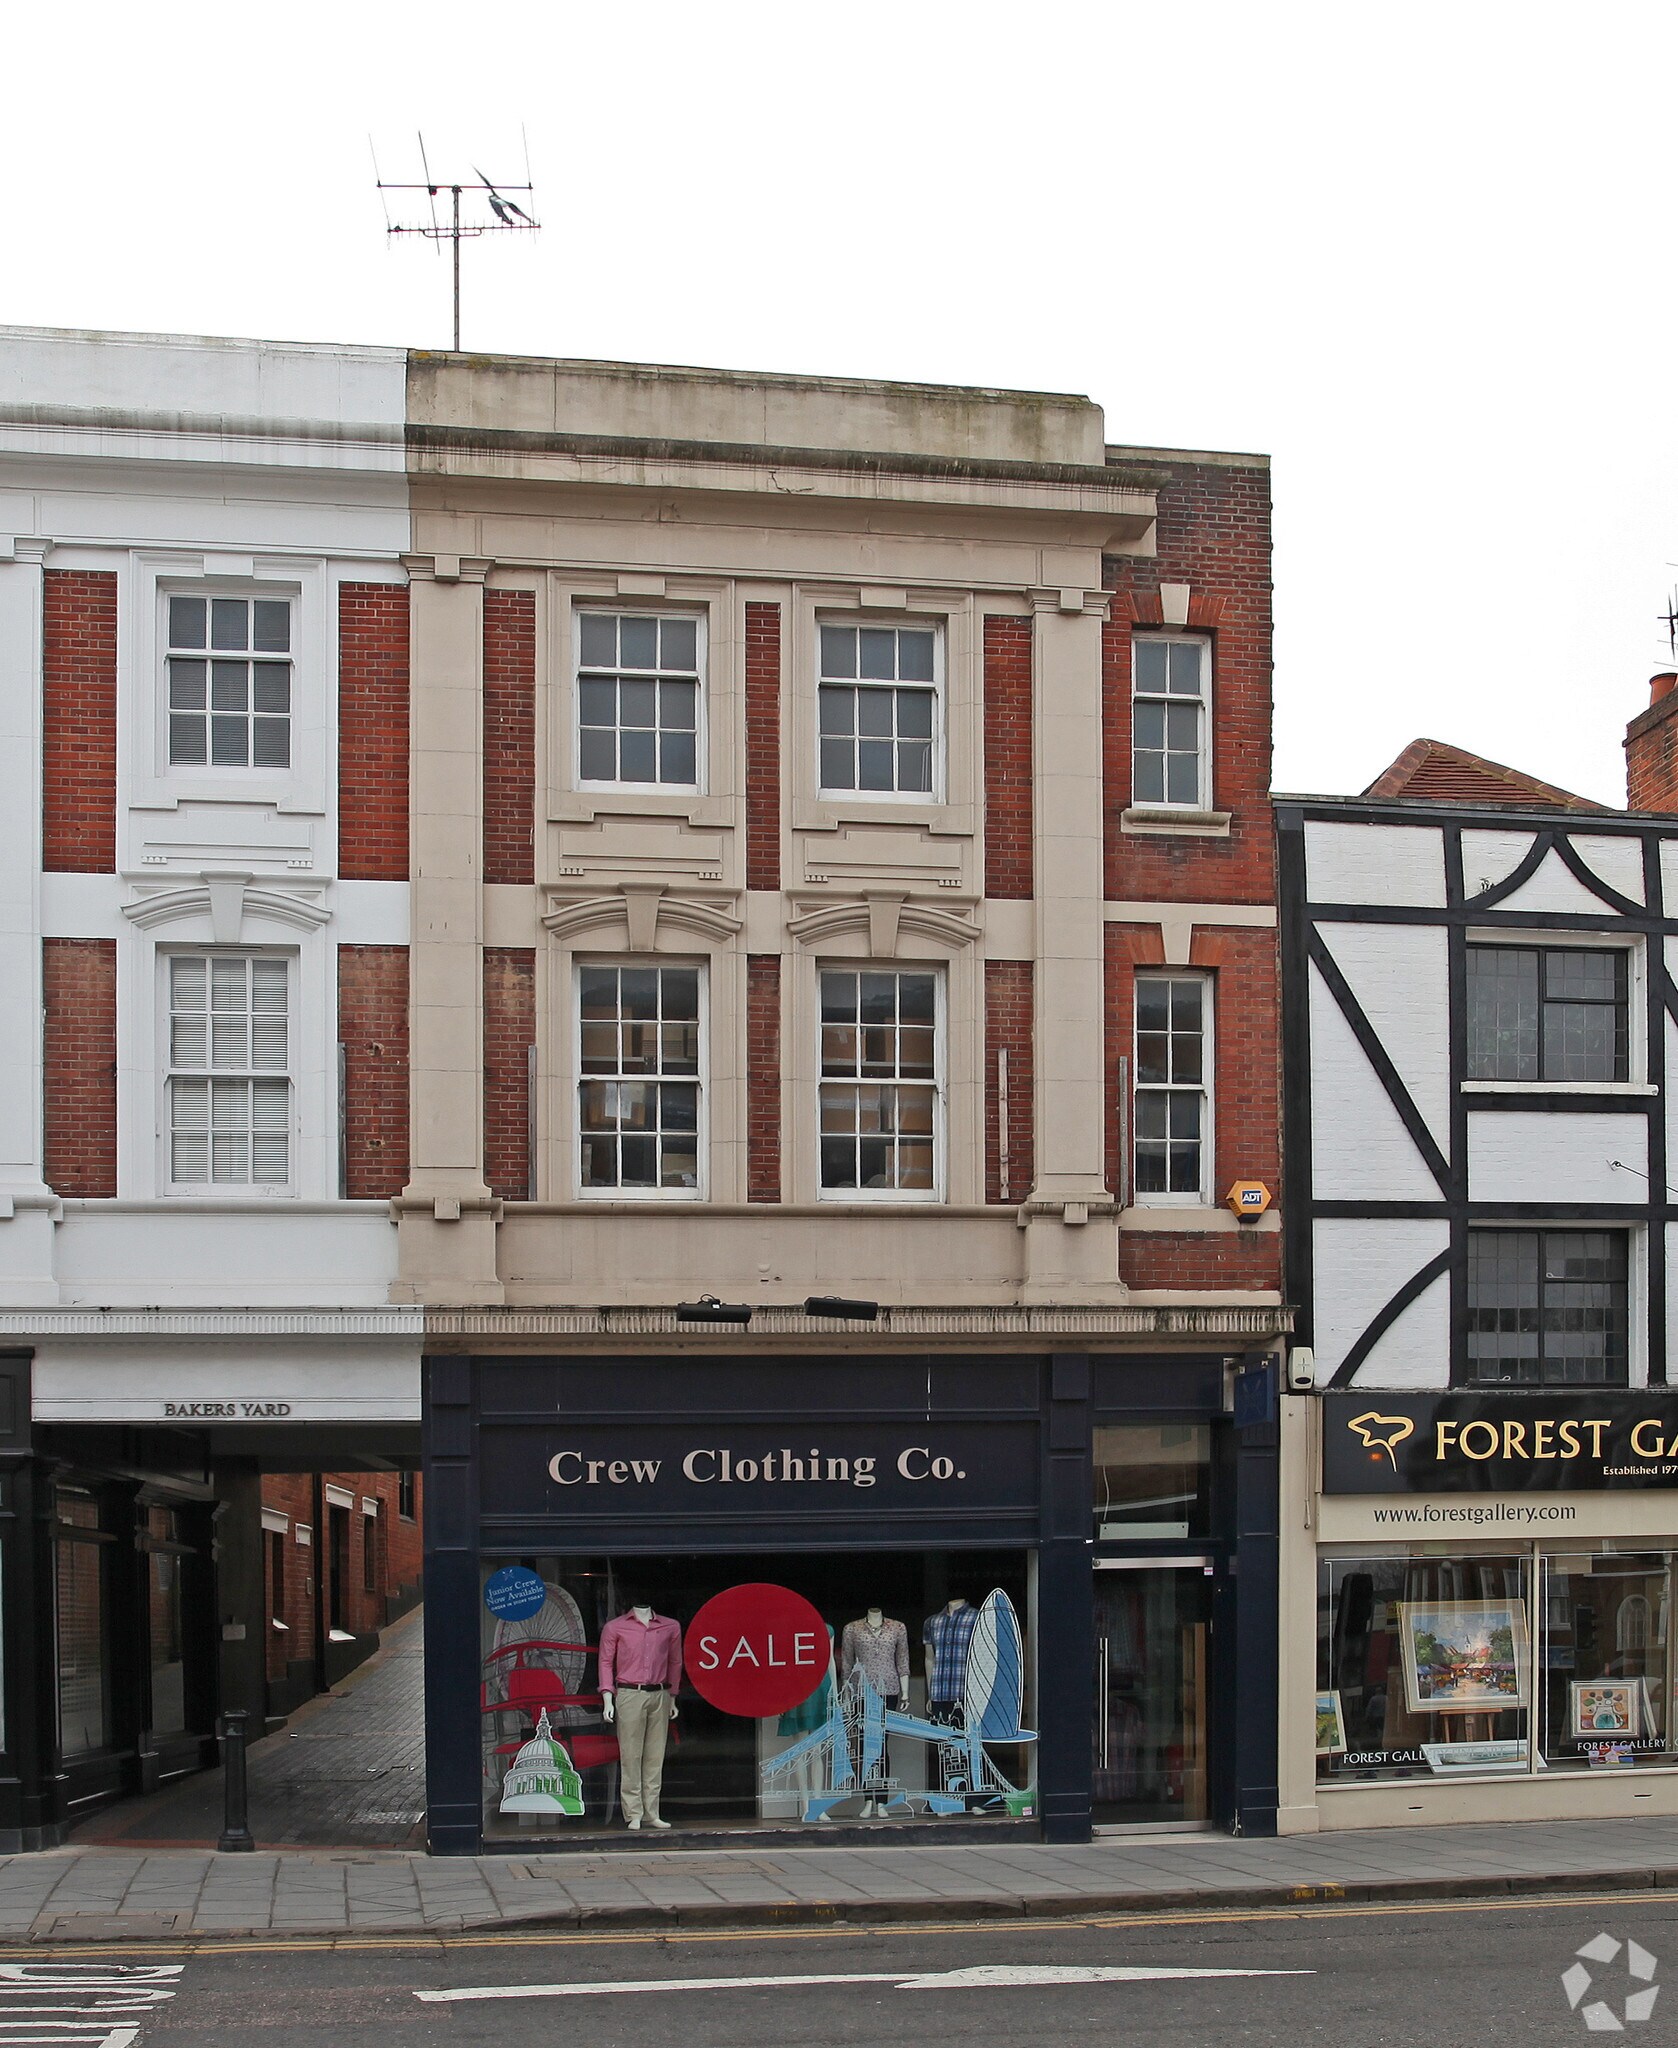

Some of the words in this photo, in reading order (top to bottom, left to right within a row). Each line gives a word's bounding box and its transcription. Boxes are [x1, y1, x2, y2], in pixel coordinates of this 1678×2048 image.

[1242, 1193, 1262, 1202] ADT
[164, 1403, 235, 1416] BAKERS
[241, 1403, 290, 1416] YARD
[1436, 1420, 1612, 1460] FOREST
[547, 1451, 662, 1485] Crew
[682, 1448, 876, 1487] Clothing
[897, 1447, 966, 1480] Co.
[1603, 1466, 1658, 1475] Established
[1662, 1465, 1678, 1474] 197
[1374, 1503, 1576, 1524] www.forestgallery.com
[486, 1596, 506, 1606] Now
[508, 1586, 544, 1600] Available
[488, 1585, 513, 1599] Junior
[514, 1580, 537, 1589] Crew
[699, 1632, 815, 1670] SALE
[1577, 1741, 1618, 1751] FOREST
[1620, 1738, 1666, 1749] GALLERY
[1343, 1751, 1392, 1764] FOREST
